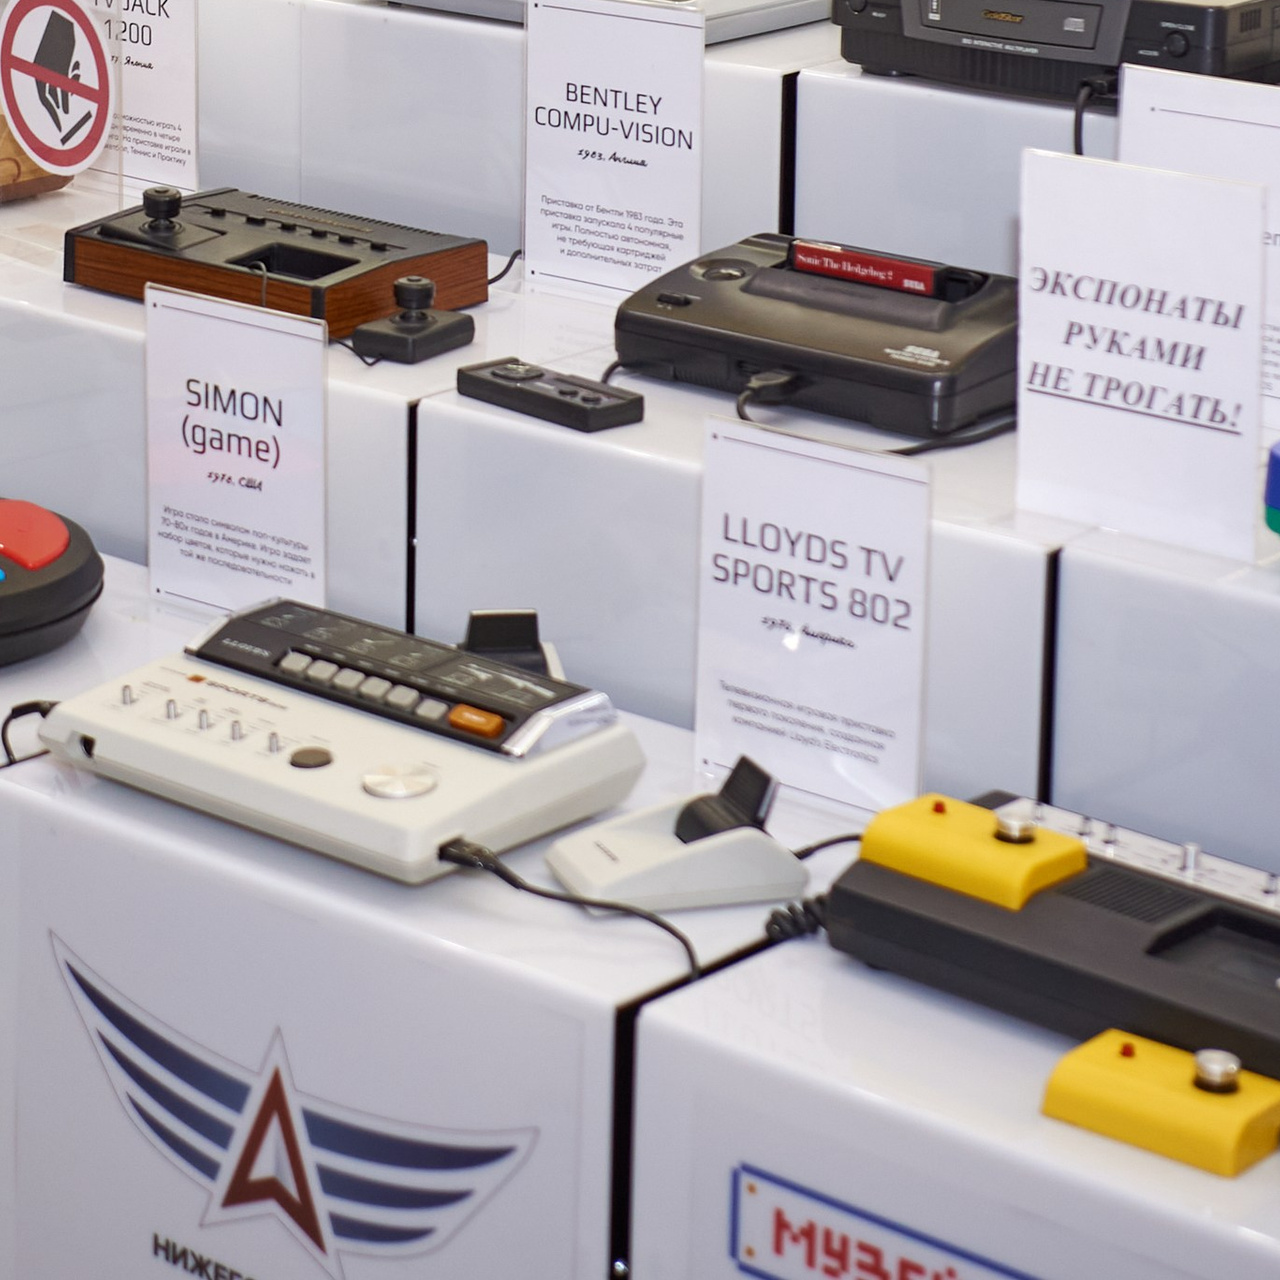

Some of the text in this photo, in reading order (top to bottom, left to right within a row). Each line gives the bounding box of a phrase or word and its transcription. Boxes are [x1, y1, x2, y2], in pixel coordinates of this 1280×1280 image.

[104, 19, 153, 47] 1200
[565, 82, 662, 116] BENTLEY
[535, 106, 693, 150] COMPU-VISION
[540, 208, 684, 240] приставка запускала 4 популярные
[541, 195, 684, 228] Приставка от Бентли 1983 года. Эта
[551, 223, 672, 251] игры. Полностью автономная,
[557, 235, 667, 261] не требующая картриджей
[566, 248, 632, 268] дополнительных
[634, 262, 662, 273] затрат
[822, 256, 840, 270] The
[841, 260, 886, 280] Hedgehog
[1029, 266, 1246, 329] ЭКСПОНАТЫ
[1062, 319, 1208, 371] РУКАМИ
[185, 378, 283, 427] SIMON
[1027, 361, 1243, 428] НЕ ТРОГАТЬ!
[182, 414, 280, 469] (game)
[163, 505, 184, 518] Игра
[185, 512, 209, 524] стала
[211, 519, 250, 534] символом
[260, 543, 281, 556] Игра
[723, 513, 905, 583] LLOYDS TV
[712, 552, 912, 631] SPORTS 802
[153, 1232, 257, 1280] НИЖЕГ
